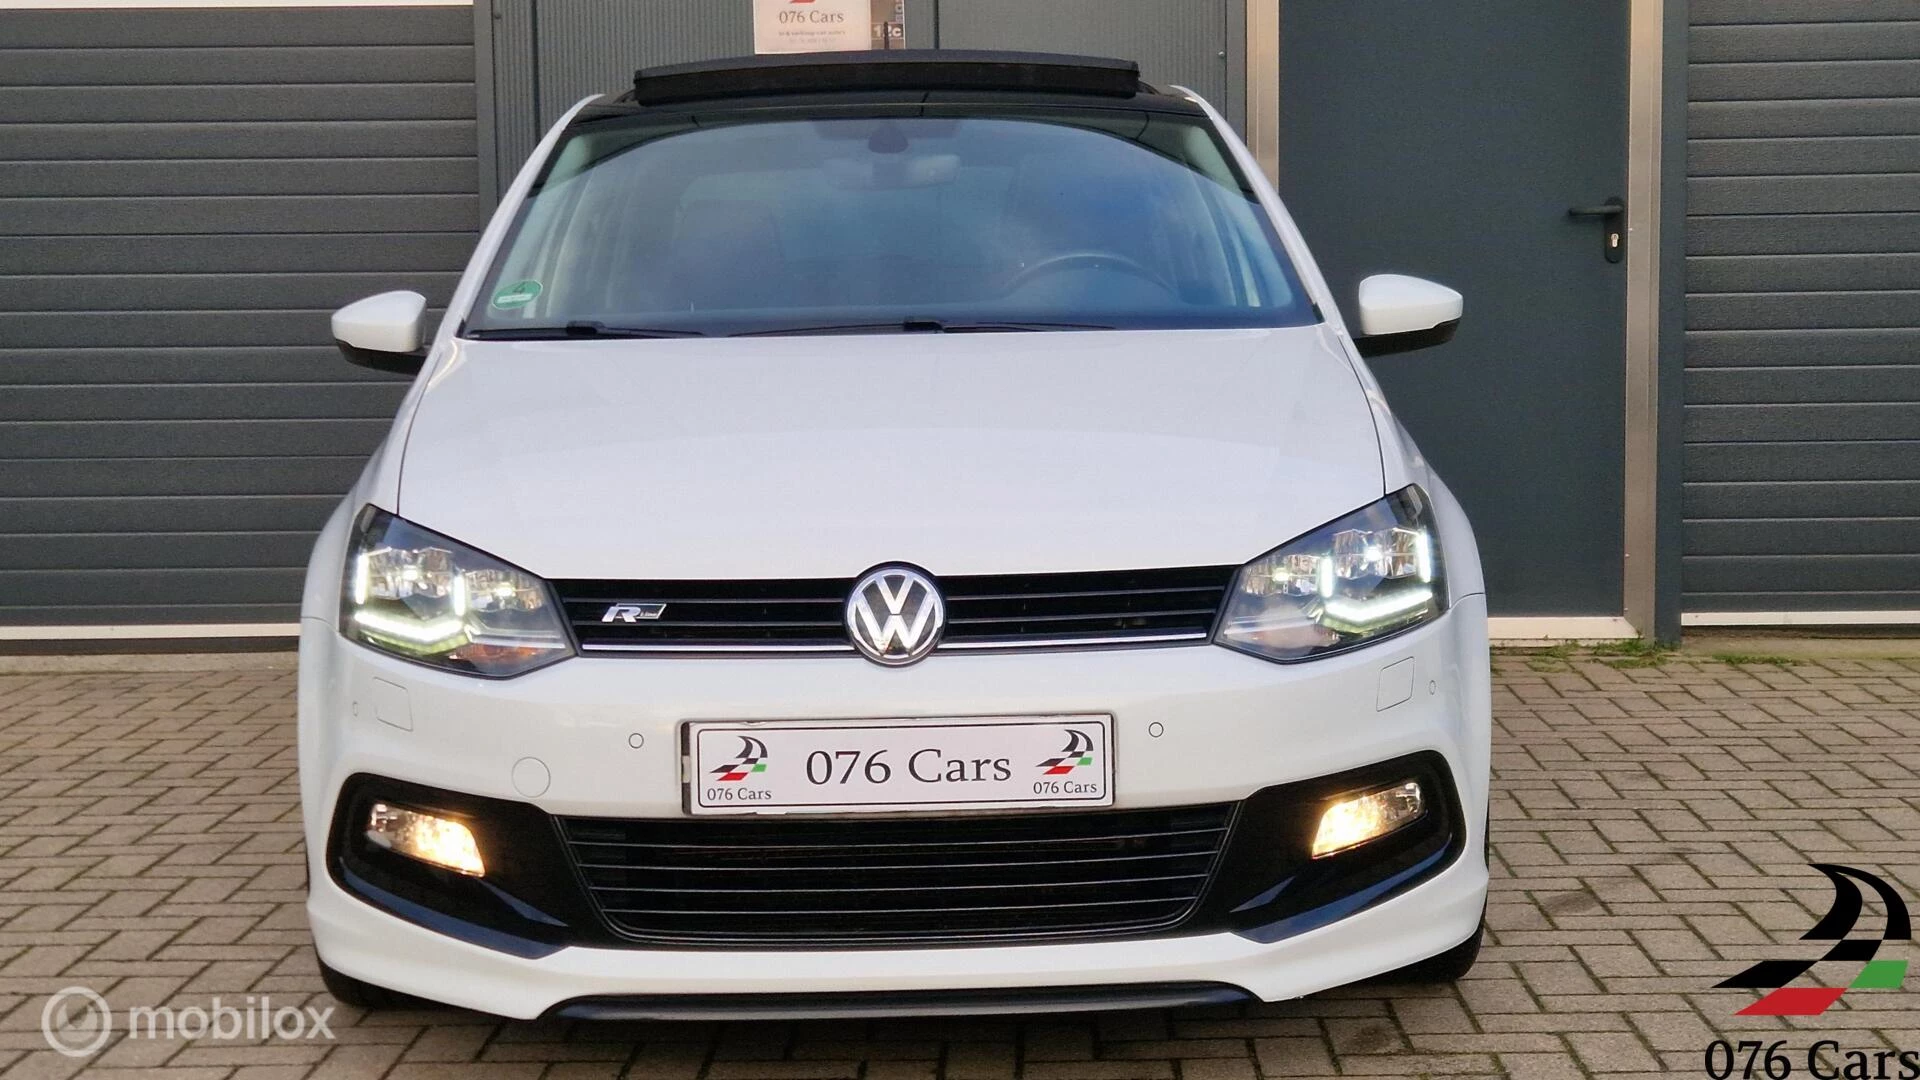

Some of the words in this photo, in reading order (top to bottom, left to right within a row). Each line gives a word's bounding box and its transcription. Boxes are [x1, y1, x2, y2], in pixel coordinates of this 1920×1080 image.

[779, 11, 805, 23] 076
[809, 10, 844, 23] Cars
[806, 749, 891, 785] 076
[908, 748, 1012, 783] Cars
[707, 788, 733, 801] 076
[737, 787, 772, 800] Cars
[1033, 781, 1059, 794] 076
[1063, 780, 1097, 794] Cars
